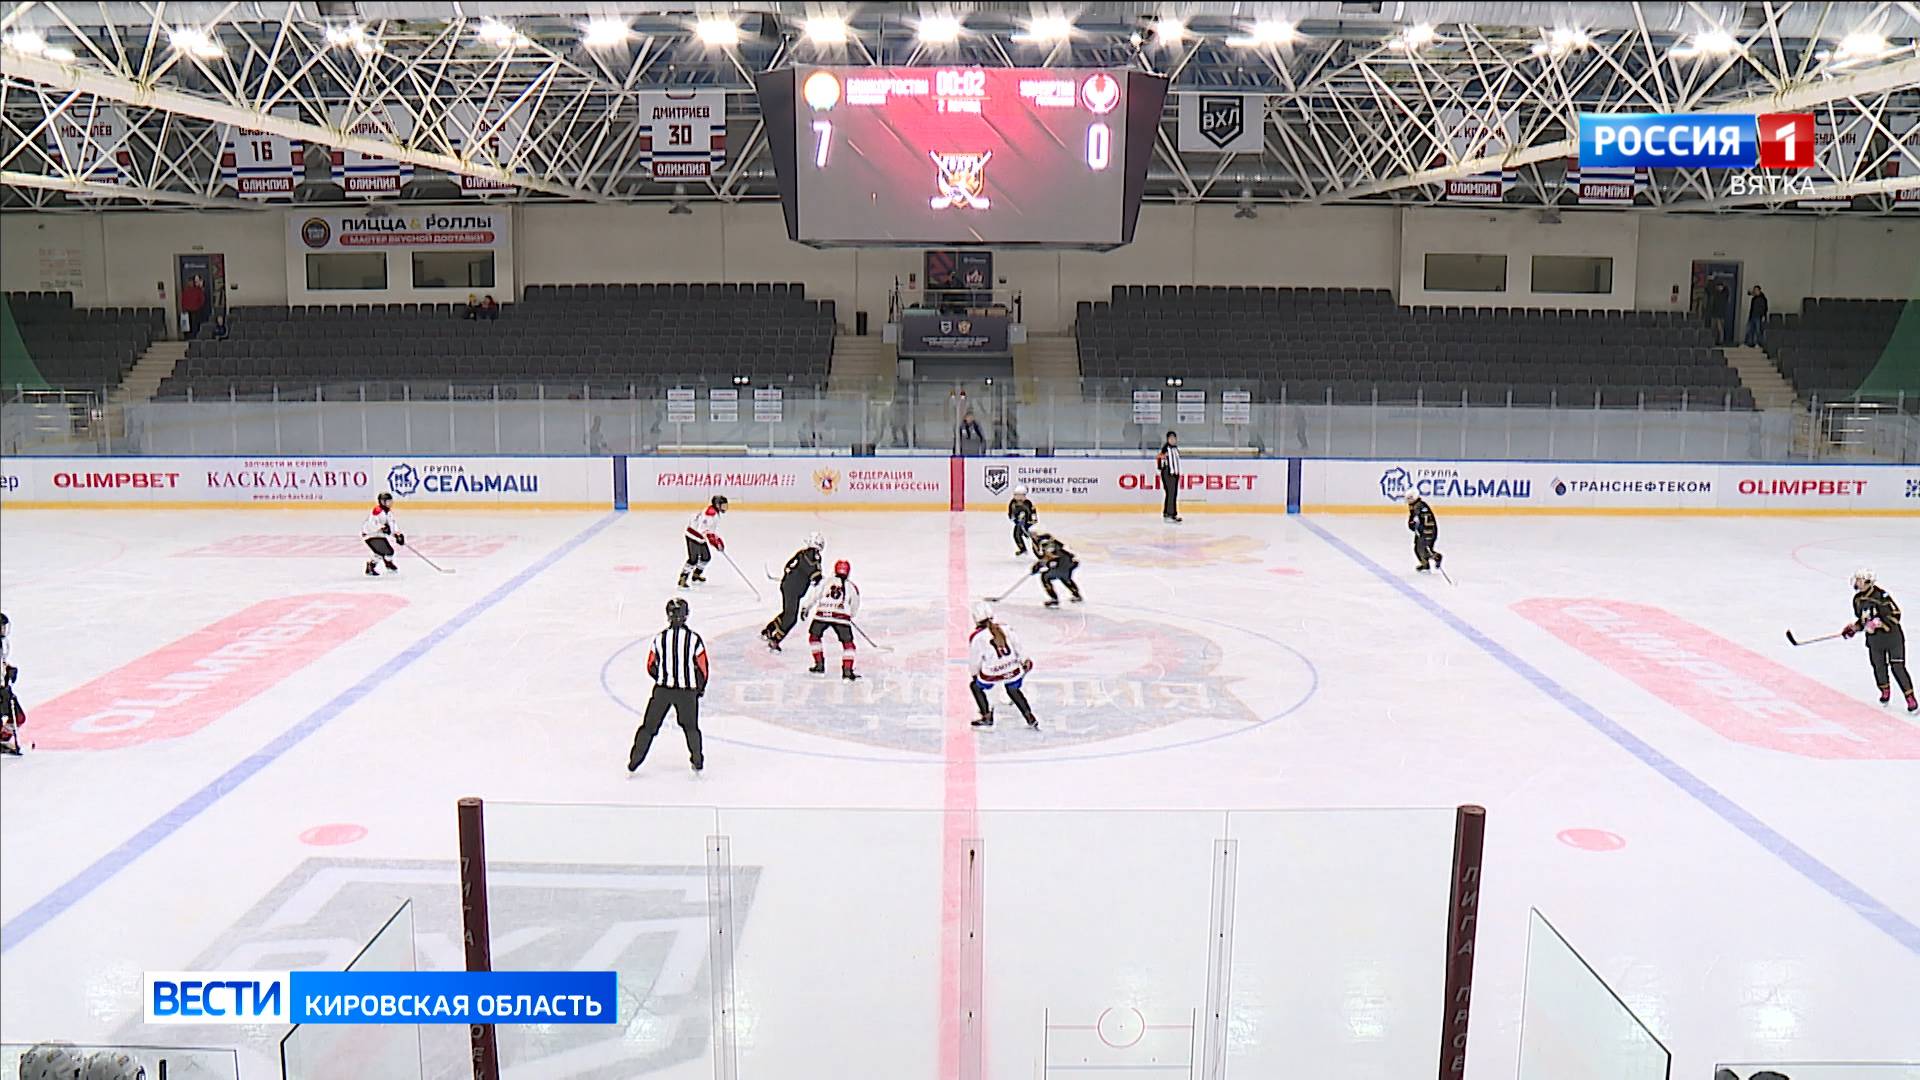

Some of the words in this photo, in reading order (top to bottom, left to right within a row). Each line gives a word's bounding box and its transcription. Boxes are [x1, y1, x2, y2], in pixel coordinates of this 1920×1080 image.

[652, 107, 710, 119] ДМИТРИЕВ
[1203, 109, 1239, 130] ВХЛ
[669, 125, 691, 145] 30
[812, 120, 832, 167] 7
[1088, 122, 1110, 170] 0
[251, 141, 272, 162] 16
[657, 163, 706, 175] ОЛИМПИЯ
[242, 177, 290, 191] ОЛИМПИЯ
[350, 177, 397, 191] ОЛИМПИЯ
[1450, 183, 1497, 196] ОЛИМПИЯ
[1584, 185, 1630, 198] ОЛИМПИЯ
[342, 217, 406, 232] ПИЦЦА
[409, 219, 421, 230] &
[426, 216, 492, 230] РОЛЛЫ
[350, 236, 386, 244] МАСТЕР
[423, 465, 465, 473] ГРУППА
[848, 471, 913, 481] ФЕДЕРАЦИЯ
[1417, 469, 1459, 477] ГРУППА
[53, 473, 179, 488] OLIMPBET
[207, 471, 368, 489] КАСКАД-АВТО
[423, 475, 538, 492] СЕЛЬМАШ
[657, 474, 722, 486] КРАСНАЯ
[724, 474, 779, 486] МАШИНА
[849, 482, 892, 491] ХОККЕЯ
[895, 482, 939, 491] РОССИИ
[1119, 474, 1257, 490] OLIPBET
[1570, 481, 1711, 492] ТРАНСНЕФТЕКОМ
[1738, 479, 1867, 496] OLIMPBET
[1417, 479, 1530, 498] СЕЛЬМАШ
[70, 600, 356, 733] OLIMPBET
[1562, 603, 1871, 742] OLIMPBET
[1457, 866, 1479, 955] ЛИГА
